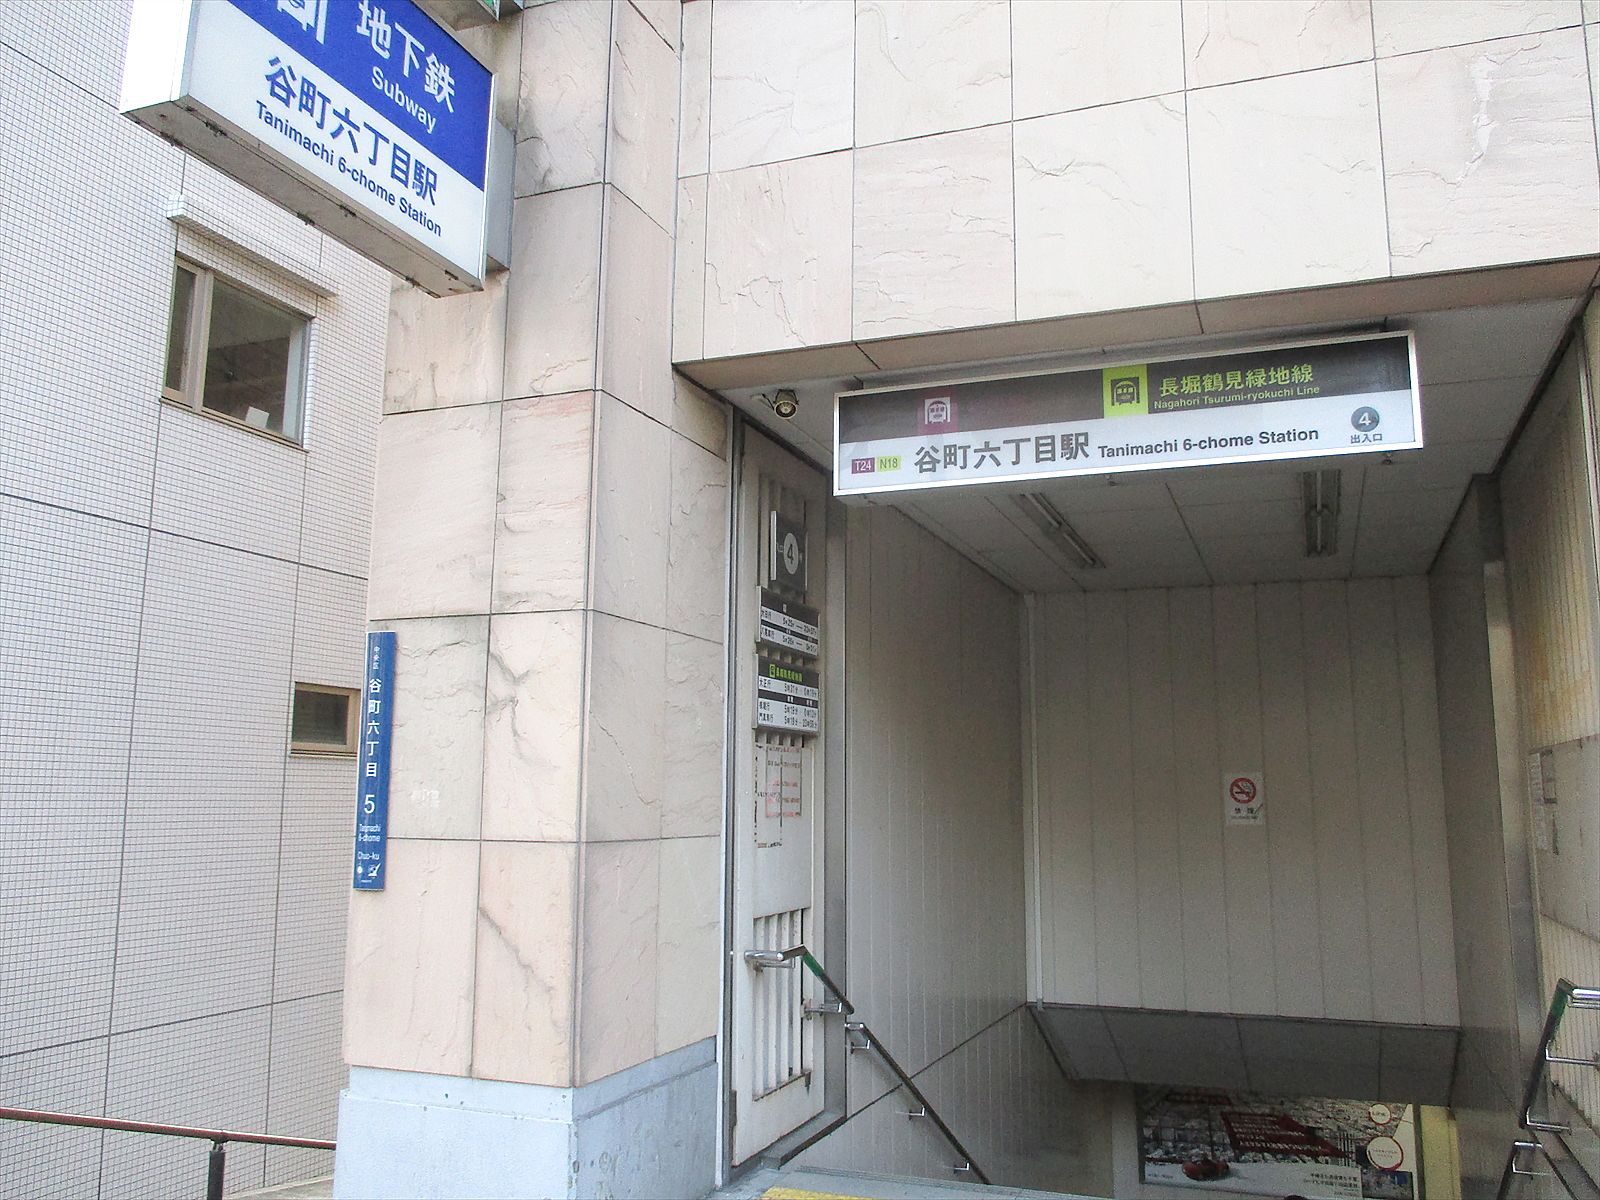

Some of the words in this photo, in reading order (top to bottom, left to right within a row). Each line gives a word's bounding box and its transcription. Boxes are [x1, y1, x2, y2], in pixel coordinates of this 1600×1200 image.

[356, 0, 454, 113] 地下鉄
[371, 66, 436, 133] Subway
[265, 56, 438, 206] 谷町六丁目駅
[256, 100, 334, 166] Tanimachi
[338, 156, 396, 206] 6-chome
[399, 197, 442, 237] Station
[1154, 397, 1200, 410] Nagahori
[1203, 386, 1294, 404] Tsurumi-ryokuchi
[1297, 384, 1320, 396] Line
[1159, 363, 1314, 397] 長堀鶴見緑地線
[1357, 412, 1371, 427] 4
[914, 432, 1090, 474] 谷町六丁目駅
[1098, 438, 1178, 458] Tanimachi
[1183, 434, 1254, 451] 6-chome
[1258, 427, 1319, 445] Station
[1350, 432, 1383, 444] 出入口
[855, 460, 872, 473] T24
[879, 457, 898, 470] N18
[787, 543, 794, 565] 4
[366, 678, 381, 777] 谷町六丁目
[364, 794, 375, 814] 5
